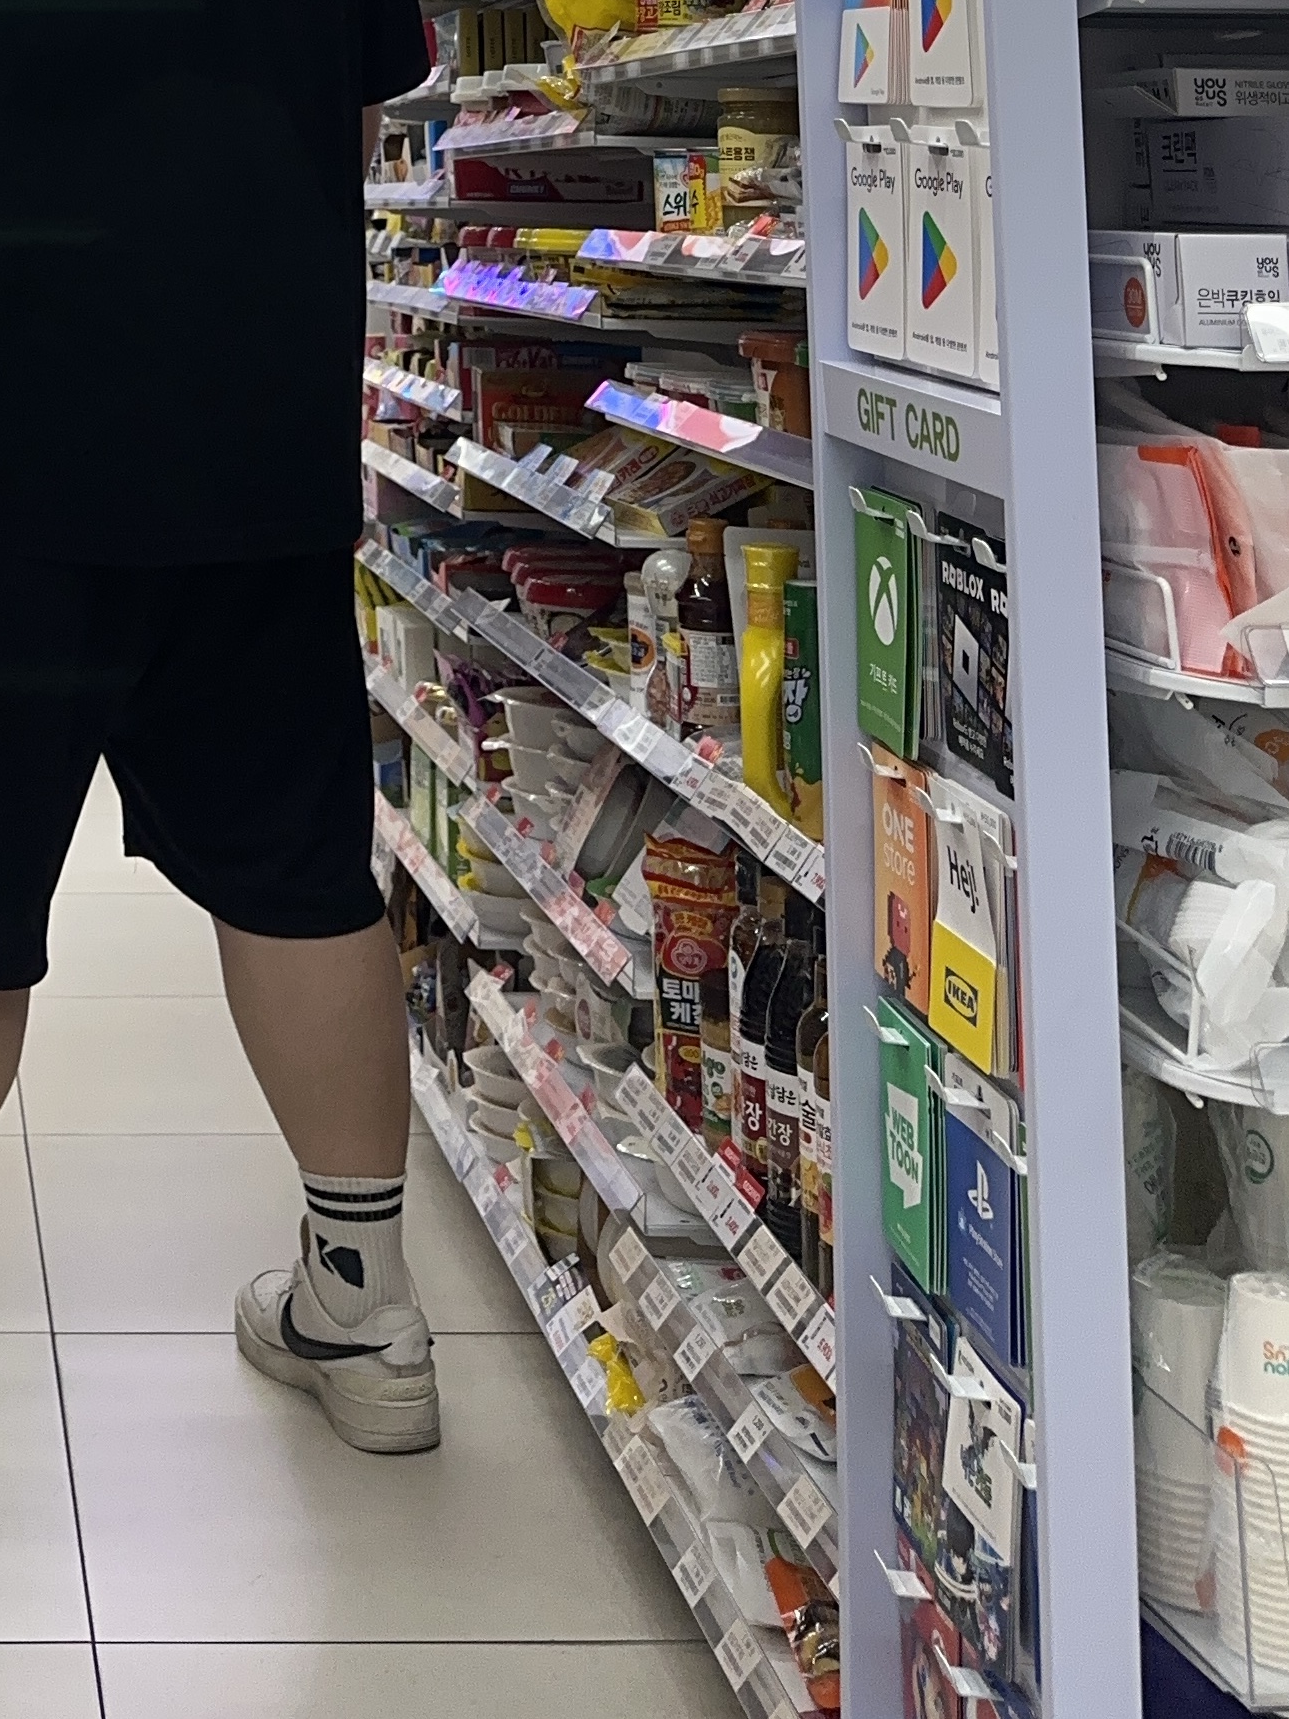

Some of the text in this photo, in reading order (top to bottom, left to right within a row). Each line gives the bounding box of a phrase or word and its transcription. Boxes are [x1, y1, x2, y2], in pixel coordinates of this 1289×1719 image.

[850, 166, 896, 194] Google Play
[914, 167, 964, 200] Google Play
[1198, 318, 1236, 327] ALUMINIUM
[857, 386, 961, 464] GIFT CARD
[940, 559, 985, 603] ROBLOX
[881, 802, 915, 854] ONE
[882, 840, 917, 887] store
[946, 844, 980, 915] Hej!
[946, 979, 976, 1015] IKEA
[891, 1106, 915, 1152] WEB
[889, 1132, 920, 1184] TOON
